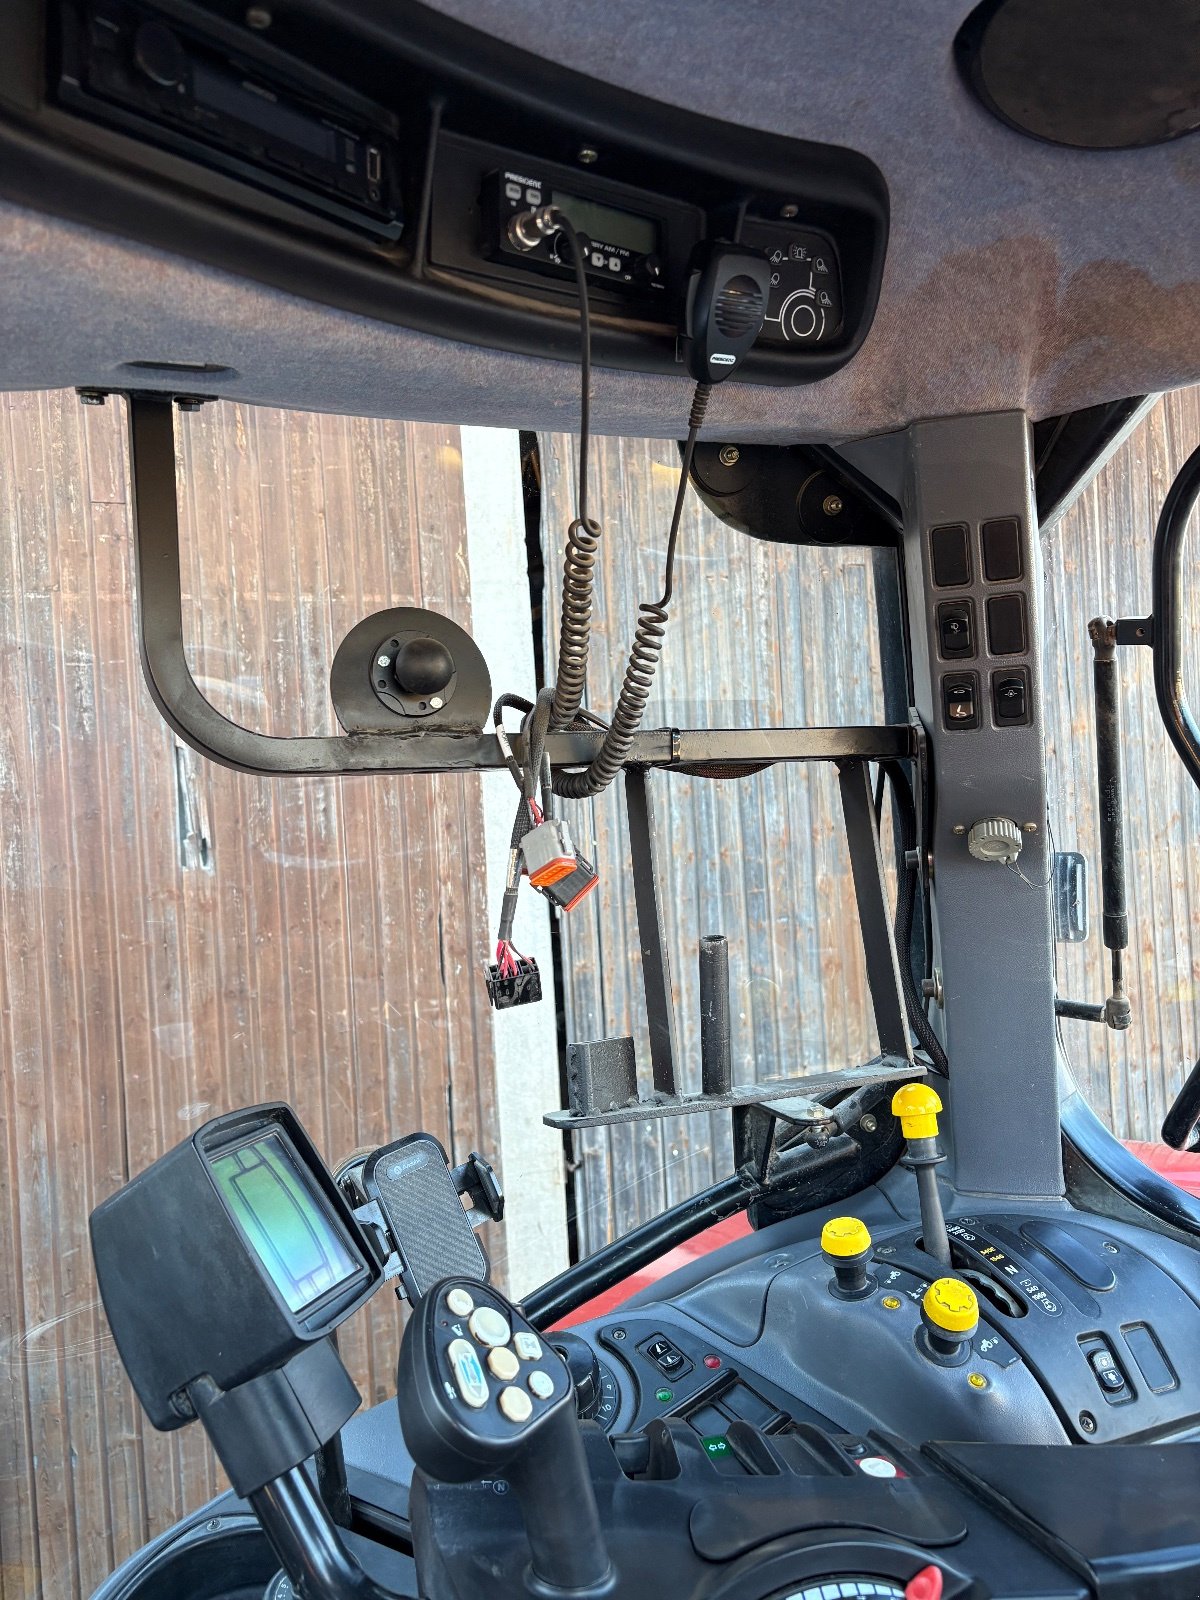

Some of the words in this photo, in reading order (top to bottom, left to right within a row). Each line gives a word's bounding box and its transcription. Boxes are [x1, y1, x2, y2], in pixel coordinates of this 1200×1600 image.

[1004, 1264, 1019, 1275] N
[1026, 1285, 1039, 1294] 540
[601, 1403, 612, 1412] 10
